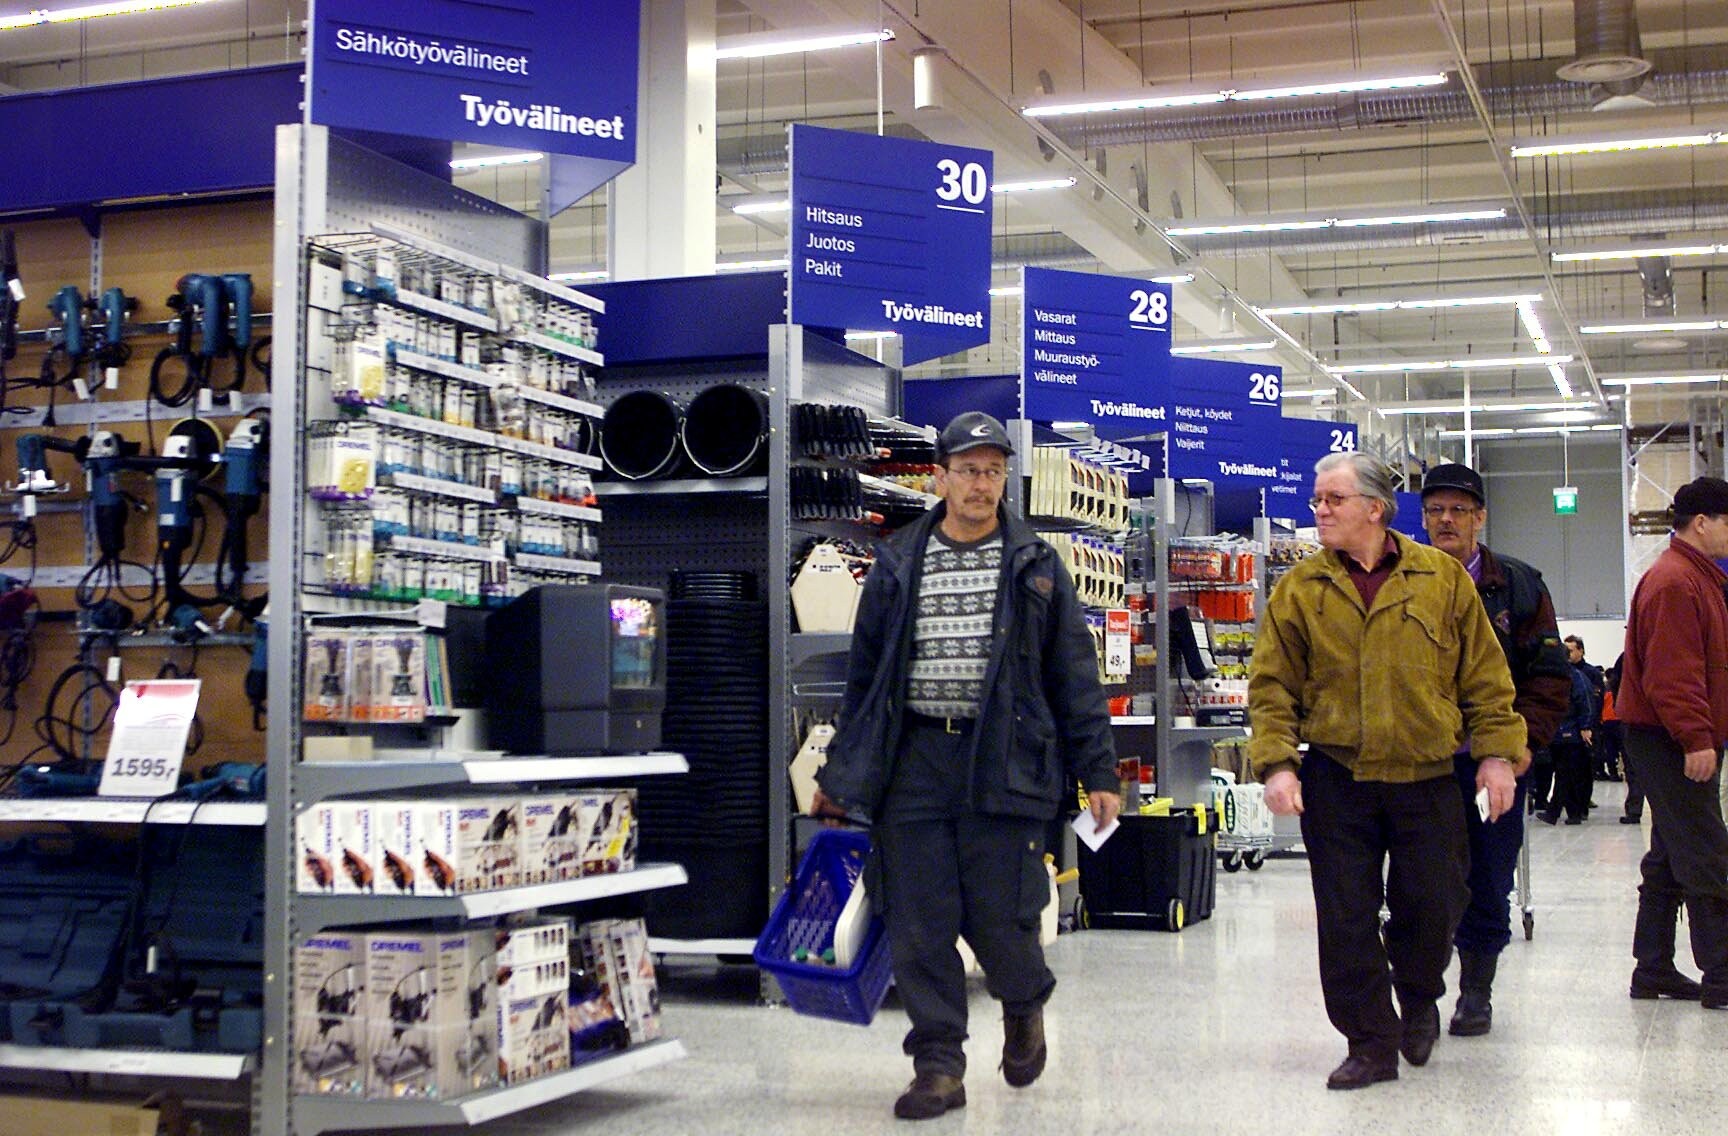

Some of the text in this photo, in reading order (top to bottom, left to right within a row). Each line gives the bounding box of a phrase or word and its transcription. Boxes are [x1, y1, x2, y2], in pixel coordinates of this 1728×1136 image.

[460, 94, 624, 140] Työvälineet
[936, 159, 987, 204] 30
[806, 206, 863, 228] Hitsaus
[806, 233, 856, 252] Juotos
[805, 258, 843, 277] Pakit
[882, 300, 983, 328] Työvälineet
[1034, 310, 1077, 325] Vasarat
[1129, 290, 1168, 325] 28
[1034, 329, 1076, 345] Mittaus
[1034, 349, 1100, 368] Muuraustyö-
[1034, 370, 1077, 385] välineet
[1249, 373, 1279, 401] 26
[1090, 400, 1165, 420] Työvälineet
[1330, 430, 1354, 452] 24
[1218, 461, 1277, 478] Työvälineet
